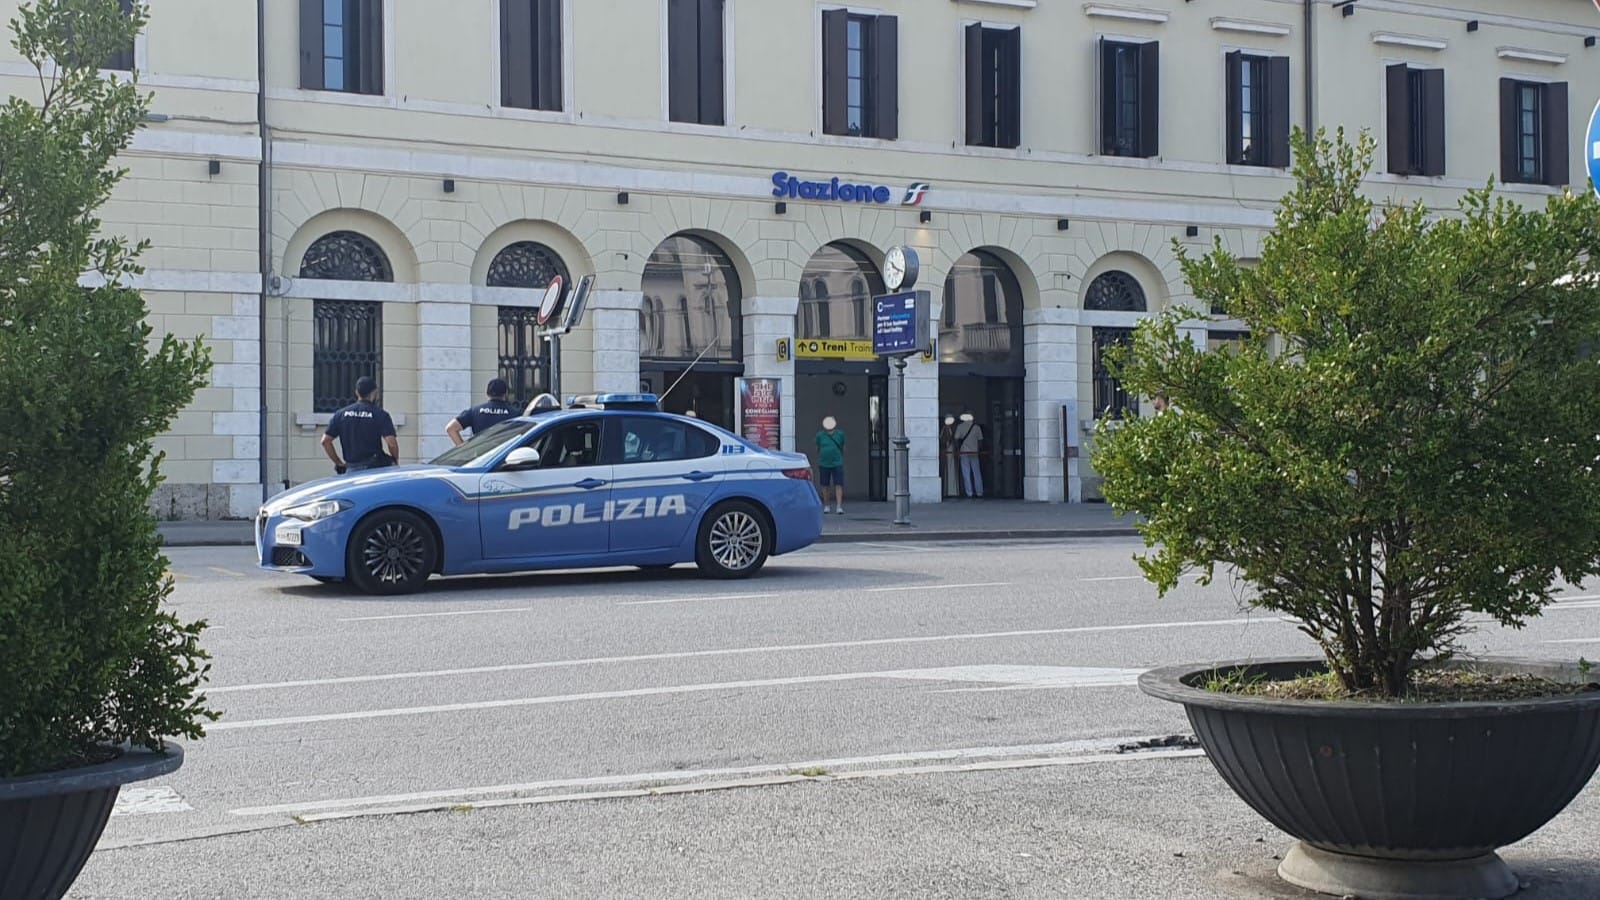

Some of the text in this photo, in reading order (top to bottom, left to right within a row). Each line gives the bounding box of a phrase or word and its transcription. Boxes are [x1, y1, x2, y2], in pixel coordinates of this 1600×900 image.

[772, 171, 890, 203] Stazione
[822, 342, 847, 352] Treni
[344, 410, 373, 419] POLIZIA
[479, 407, 509, 415] POLIZIA
[722, 444, 745, 455] 113
[508, 494, 687, 531] POLIZIA
